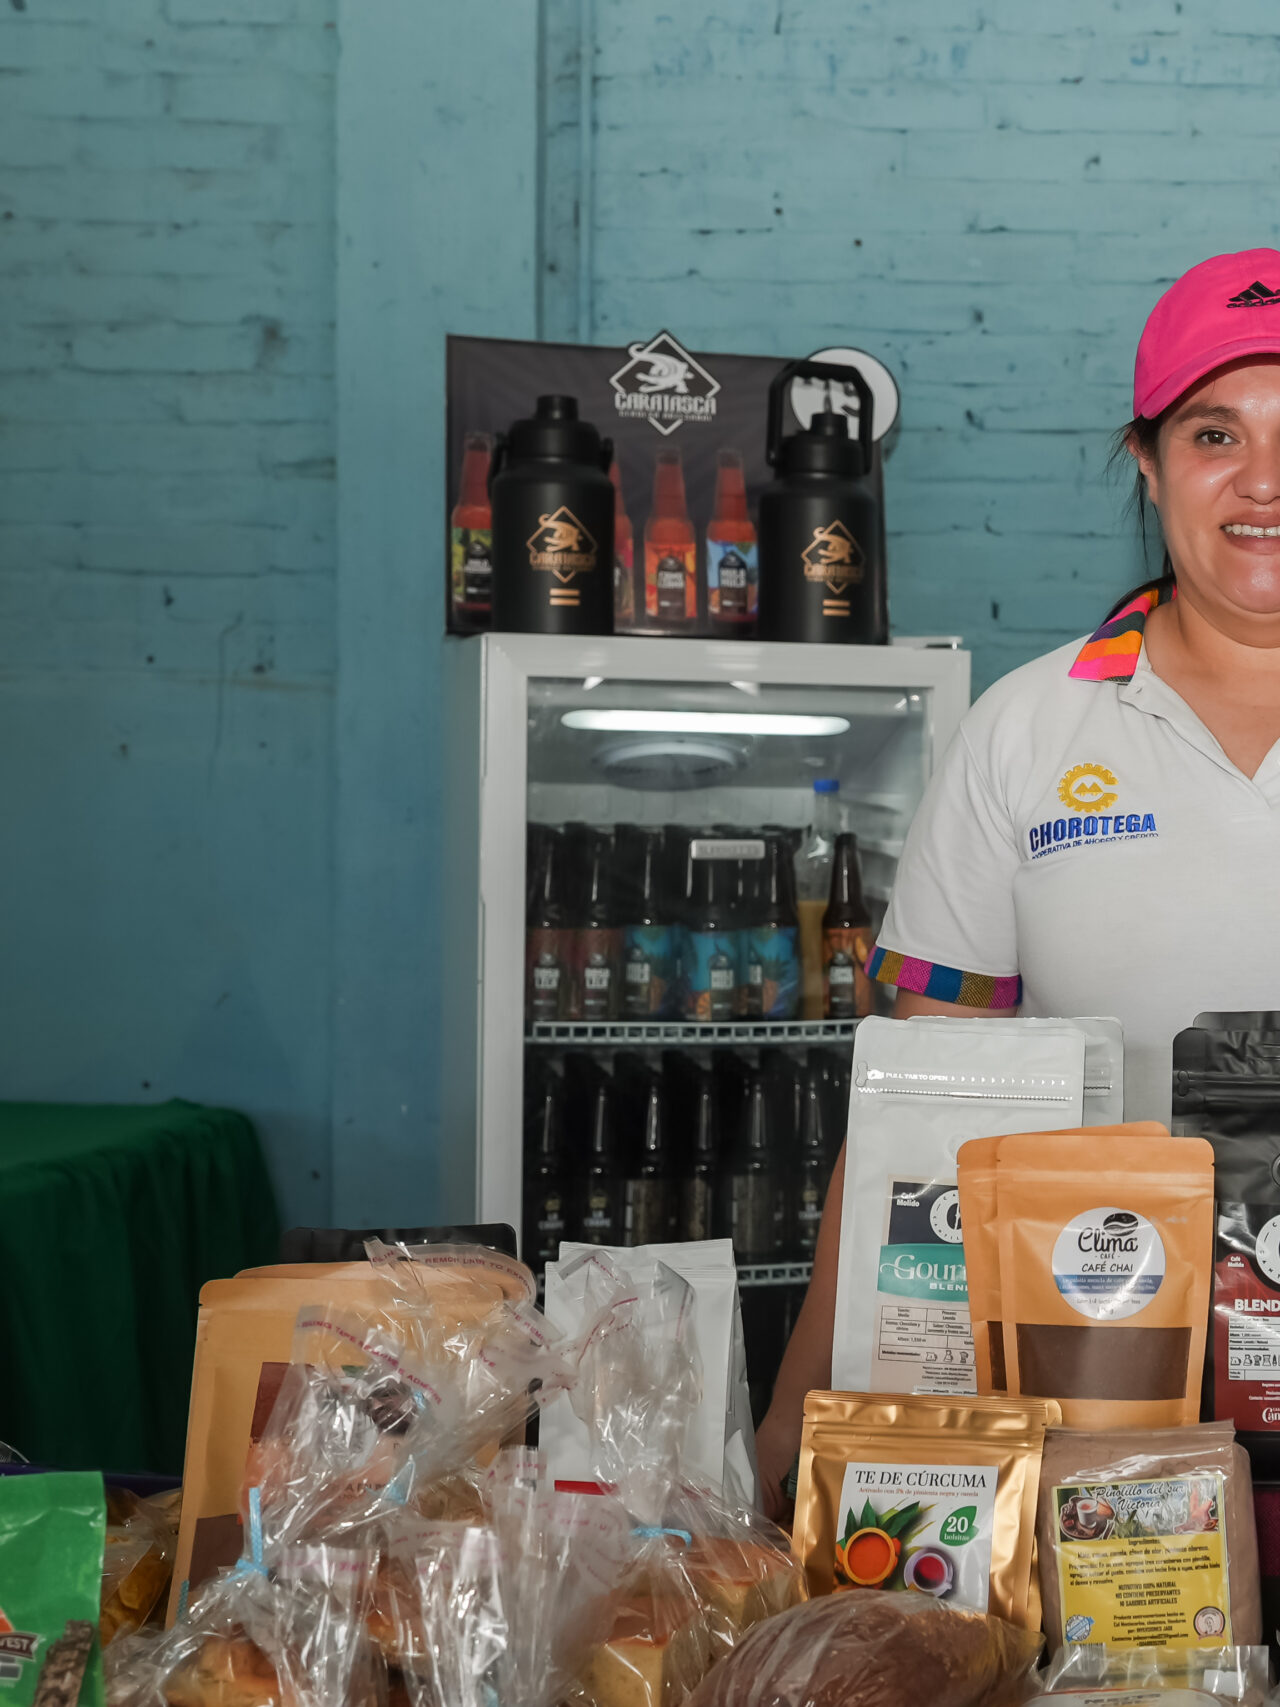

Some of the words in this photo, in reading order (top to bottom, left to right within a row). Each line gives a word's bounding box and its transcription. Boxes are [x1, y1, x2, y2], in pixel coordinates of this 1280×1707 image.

[1029, 813, 1156, 852] CHOROTEGA
[896, 1199, 920, 1207] Molido
[1078, 1227, 1138, 1252] Clima
[880, 1254, 967, 1281] Gour
[1081, 1261, 1107, 1273] CAFÉ
[1110, 1263, 1133, 1273] CHAI
[856, 1470, 876, 1484] TE
[880, 1471, 902, 1486] DE
[906, 1470, 987, 1488] CÚRCUMA
[1096, 1485, 1142, 1498] Pinolillo
[946, 1516, 969, 1533] 20
